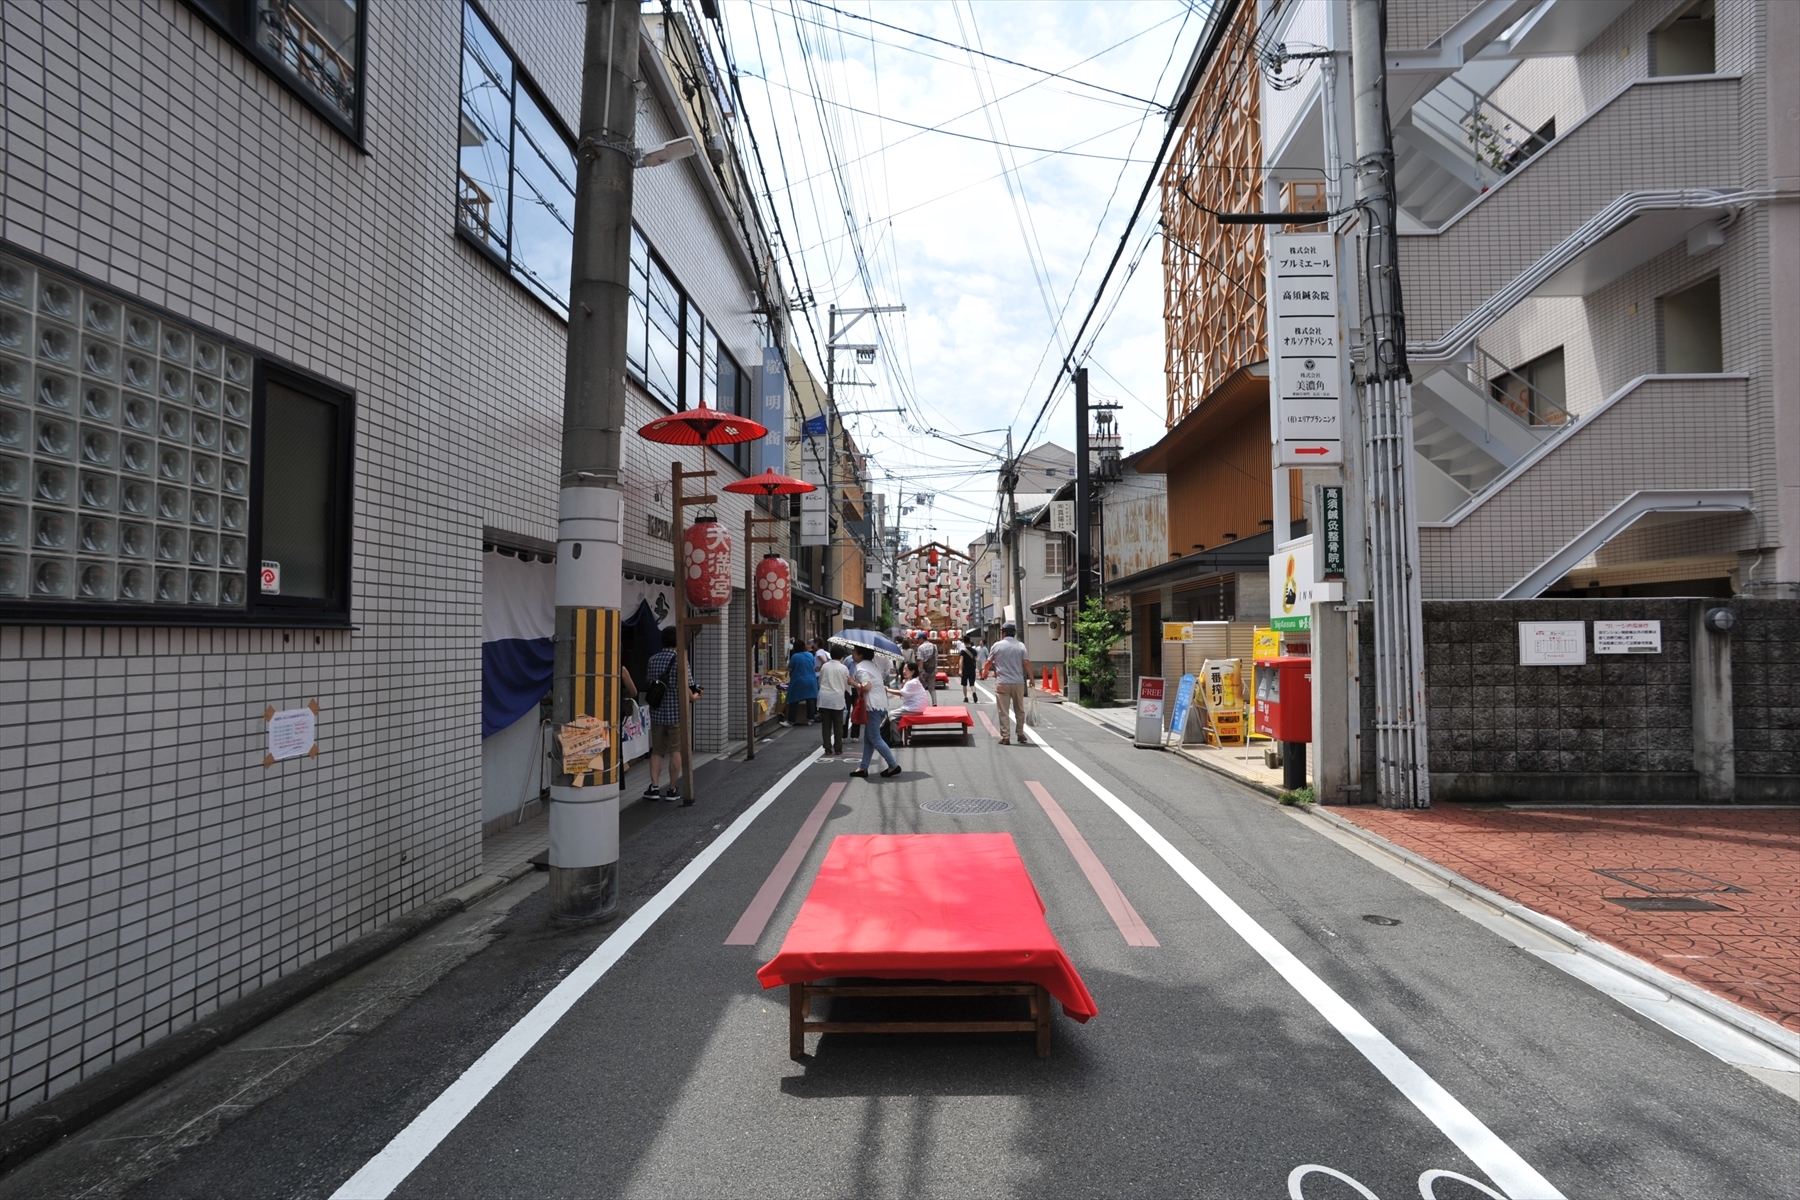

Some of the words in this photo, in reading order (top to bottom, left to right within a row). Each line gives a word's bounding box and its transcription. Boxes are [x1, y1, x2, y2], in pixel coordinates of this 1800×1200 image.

[1290, 246, 1317, 254] 株式会社
[1283, 290, 1330, 301] 高須鍼灸院
[1295, 327, 1322, 335] 株式会社
[1327, 488, 1340, 563] 高須鍼灸整骨院
[706, 527, 732, 599] 天満宮
[1211, 666, 1223, 706] 一番搾り
[1141, 688, 1163, 697] FREE
